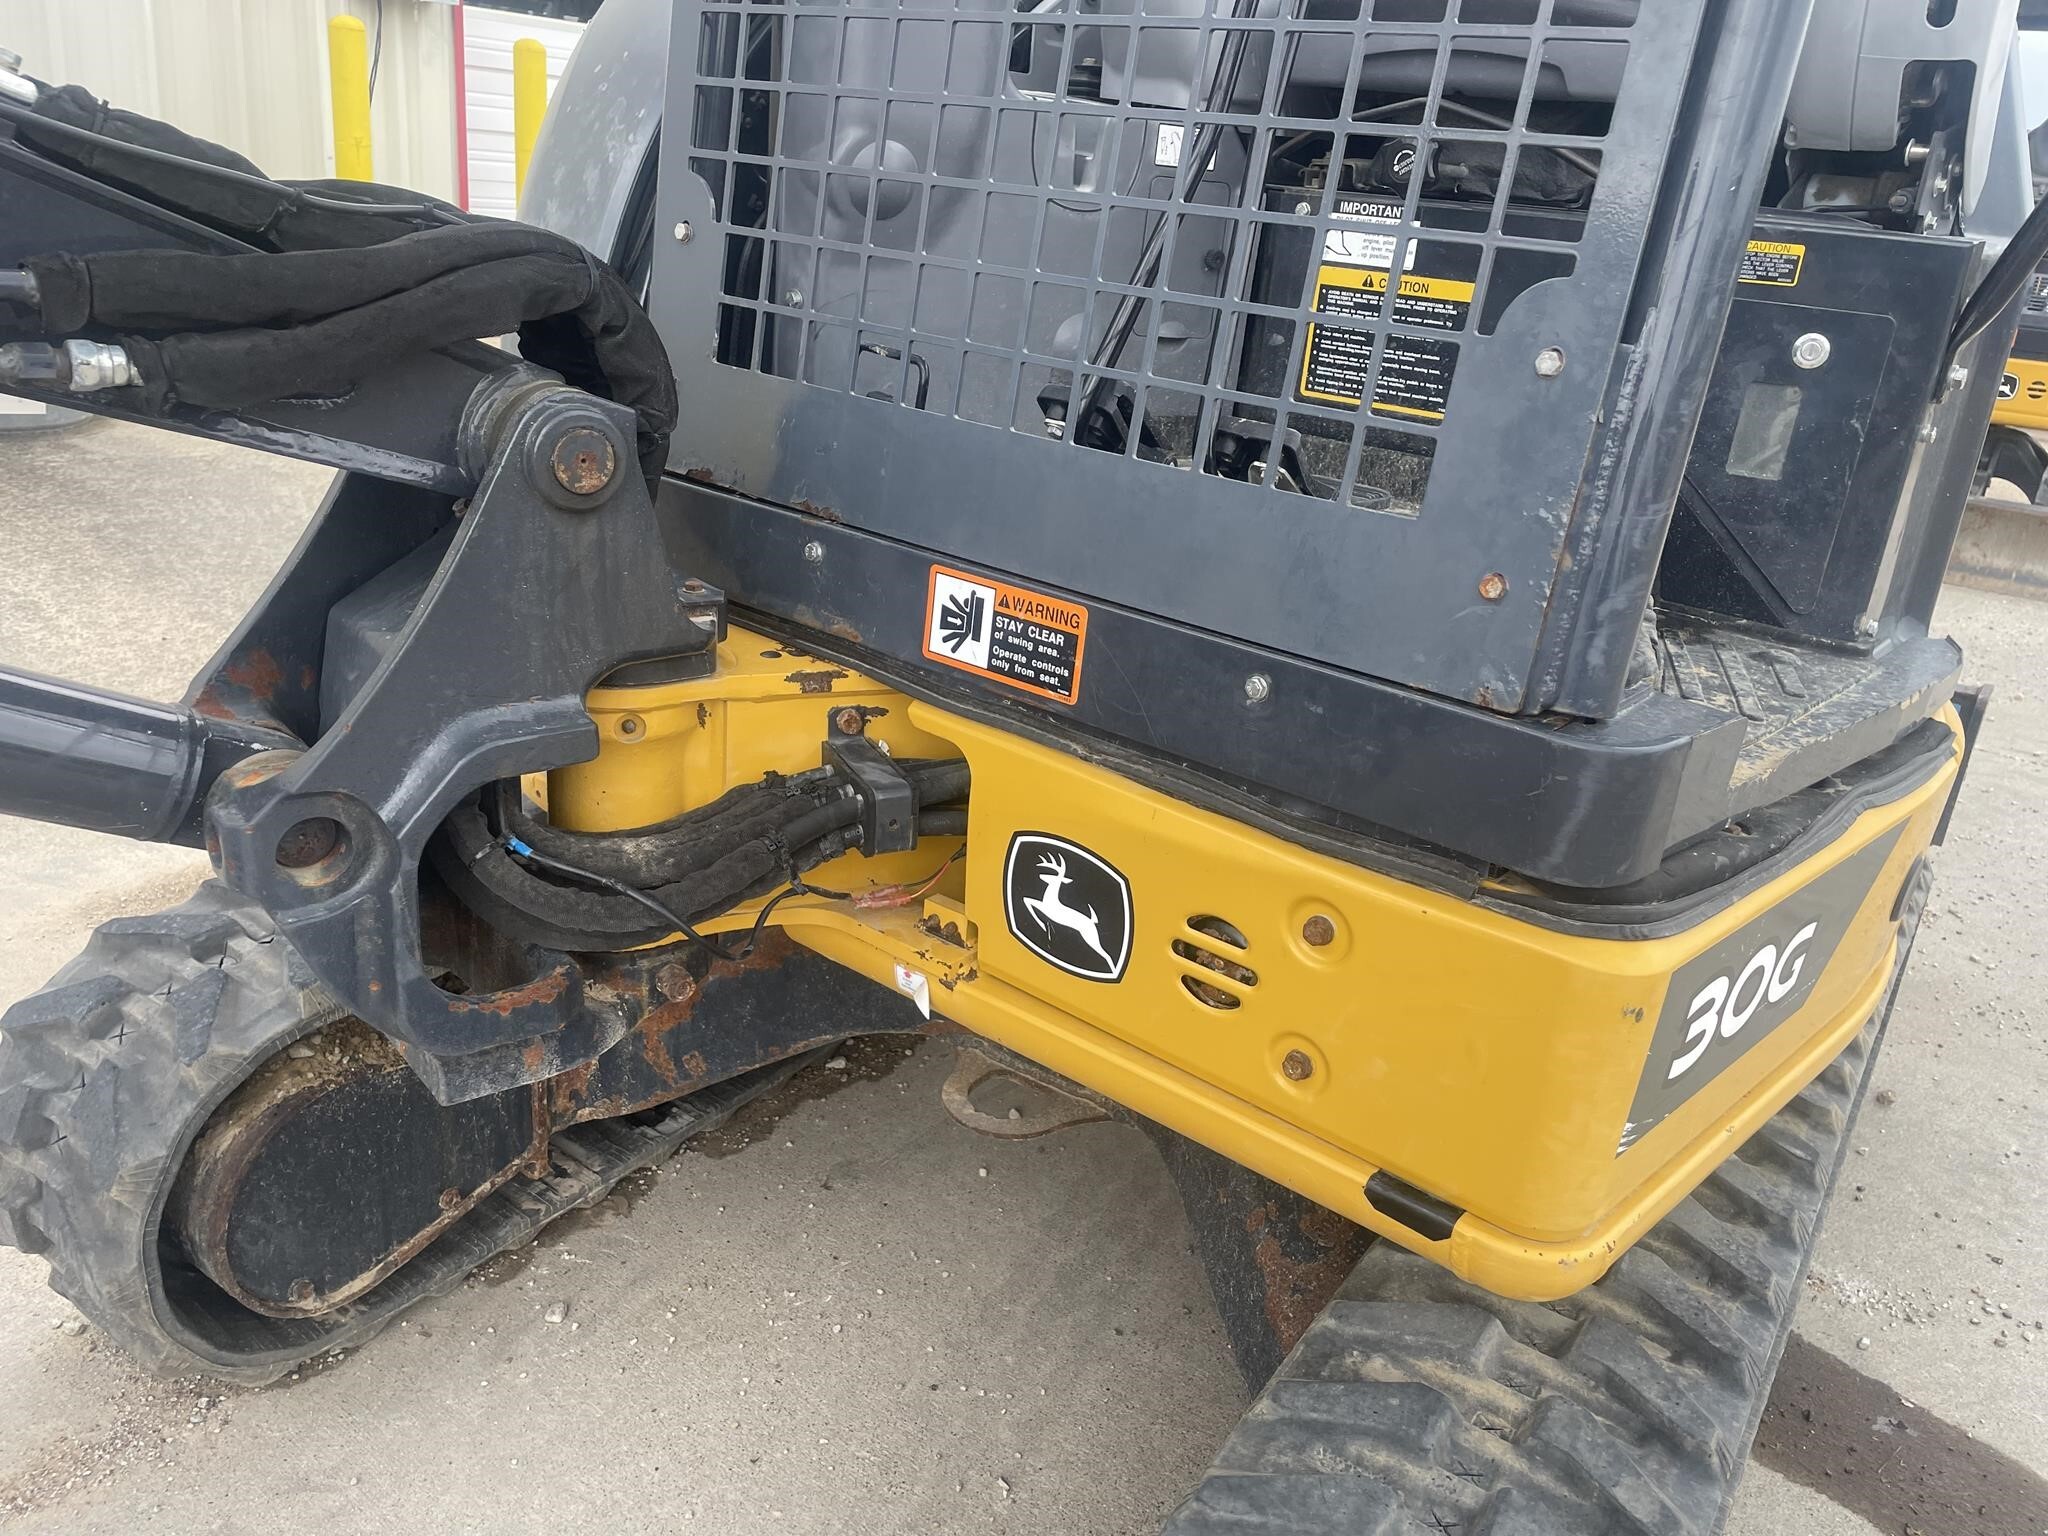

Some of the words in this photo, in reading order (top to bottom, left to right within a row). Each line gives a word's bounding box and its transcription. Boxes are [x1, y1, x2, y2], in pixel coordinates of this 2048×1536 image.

[1340, 201, 1404, 218] IMPORTAN
[1013, 595, 1080, 630] WARNING
[994, 631, 1003, 640] of
[1008, 635, 1034, 651] swing
[1038, 645, 1060, 658] area.
[996, 616, 1023, 634] STAY
[1028, 625, 1064, 646] CLEAR
[992, 659, 1009, 671] only
[1015, 664, 1035, 677] from
[1040, 674, 1061, 686] seat.
[993, 646, 1027, 663] Operate
[1032, 660, 1069, 677] controls
[1668, 922, 1817, 1079] 30G
